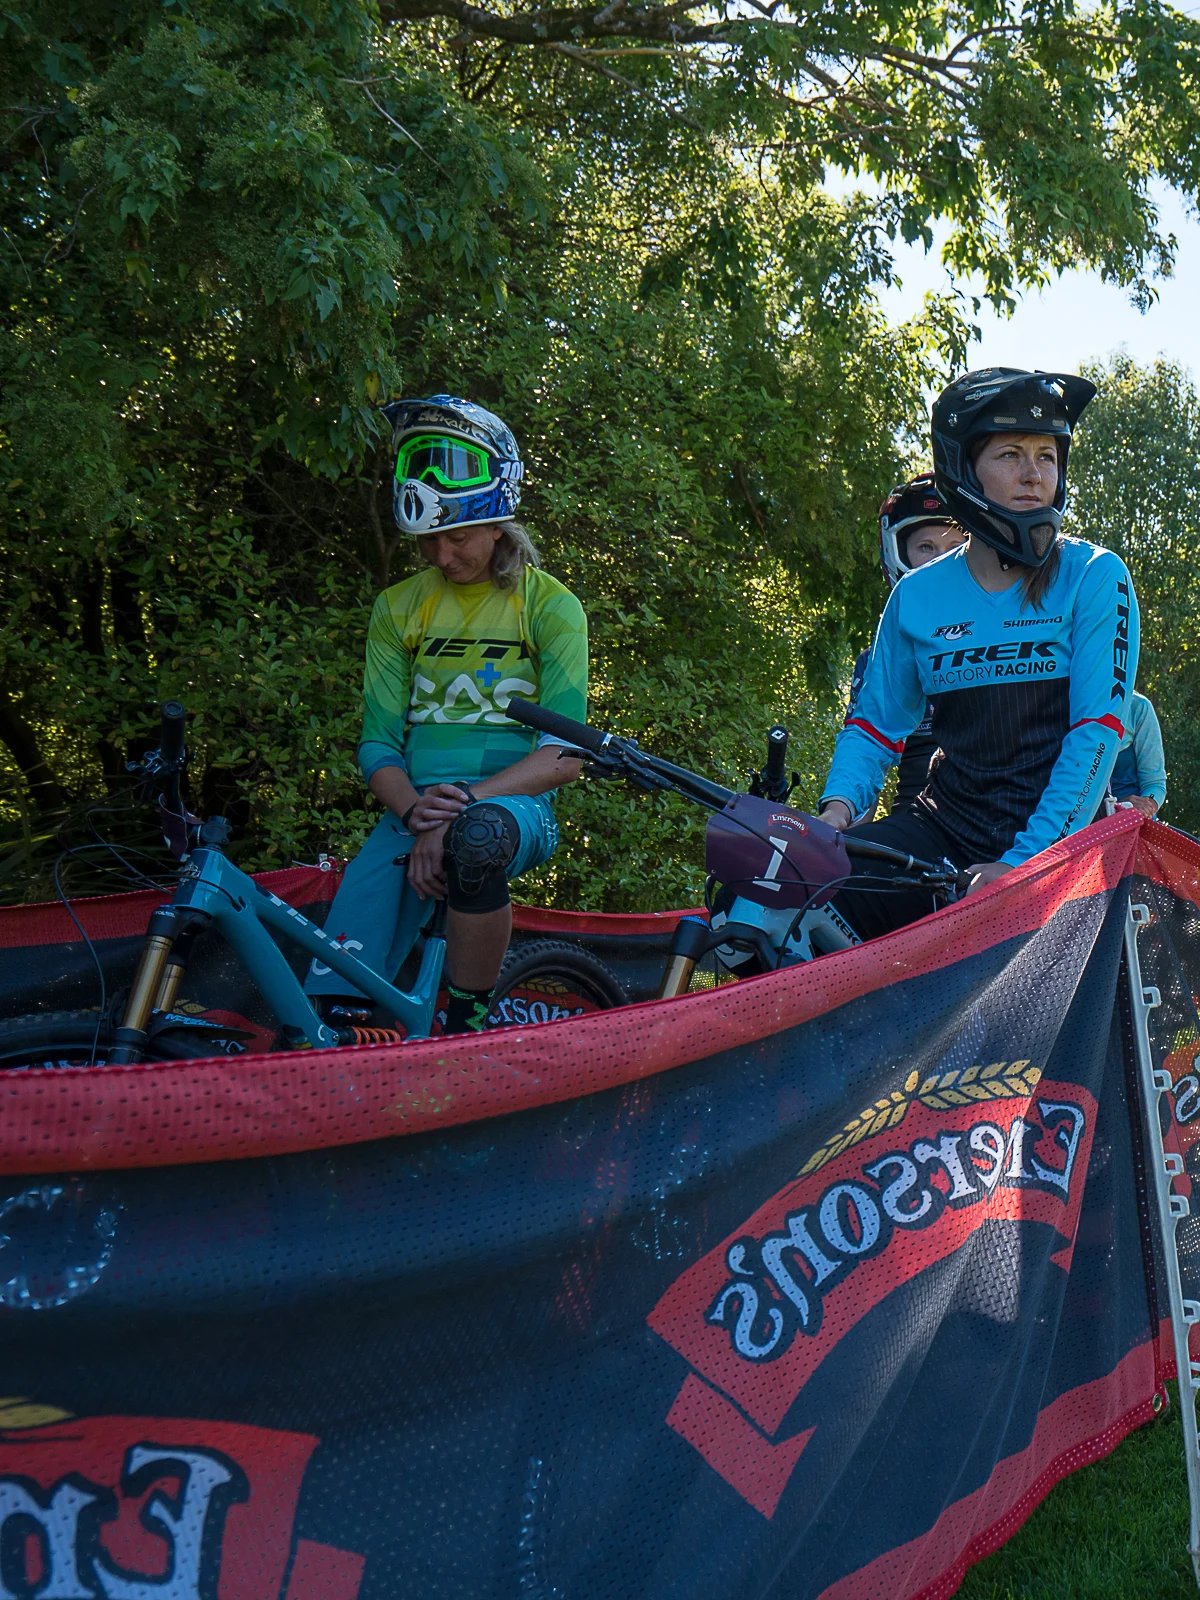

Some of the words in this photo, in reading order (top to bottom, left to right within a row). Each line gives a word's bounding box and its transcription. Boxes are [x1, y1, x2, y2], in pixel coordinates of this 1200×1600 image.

[931, 621, 975, 641] FOX
[1003, 615, 1063, 629] SHIMANO
[1110, 574, 1131, 703] TREK
[928, 641, 1061, 672] TREK
[771, 813, 806, 833] Emerson's
[752, 835, 789, 893] 1
[823, 903, 861, 947] TREK
